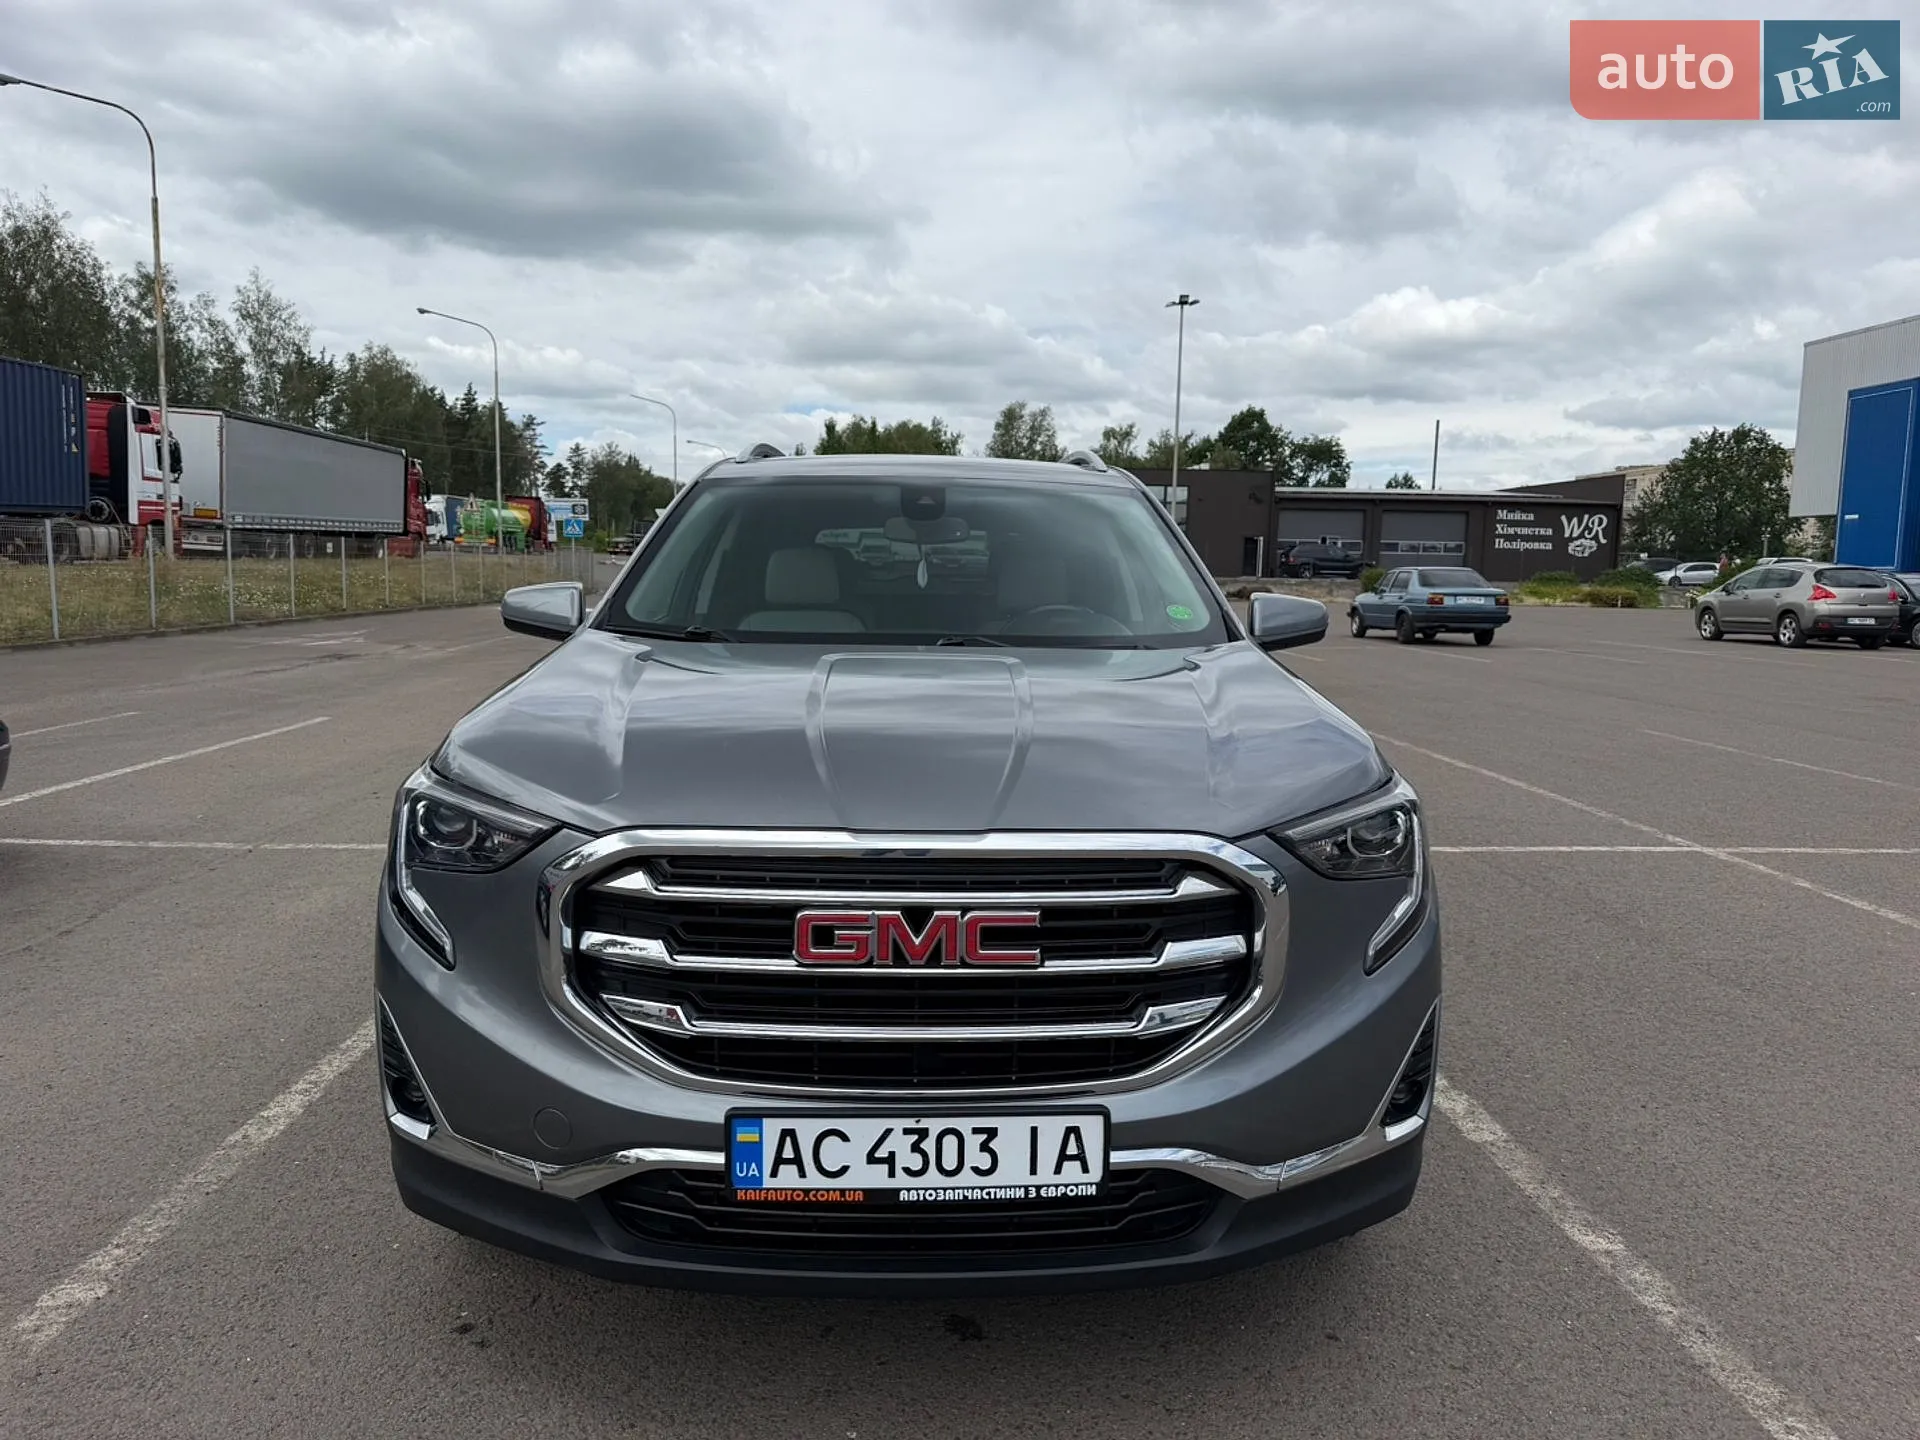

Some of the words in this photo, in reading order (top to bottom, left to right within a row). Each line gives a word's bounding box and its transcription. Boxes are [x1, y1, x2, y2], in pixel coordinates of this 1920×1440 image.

[1495, 509, 1535, 521] Мийка
[1495, 524, 1553, 536] Хімчистка
[1494, 538, 1553, 552] Поліровка
[793, 910, 1041, 966] GMC
[769, 1127, 851, 1180] AC
[865, 1125, 999, 1179] 4303
[1029, 1124, 1091, 1176] IA
[735, 1162, 760, 1178] UA
[736, 1189, 864, 1202] KAIFAUTO.COM.UA
[900, 1188, 1025, 1202] АВТОЗАПЧАСТИНИ
[1040, 1184, 1097, 1197] ЄВРОПИ
